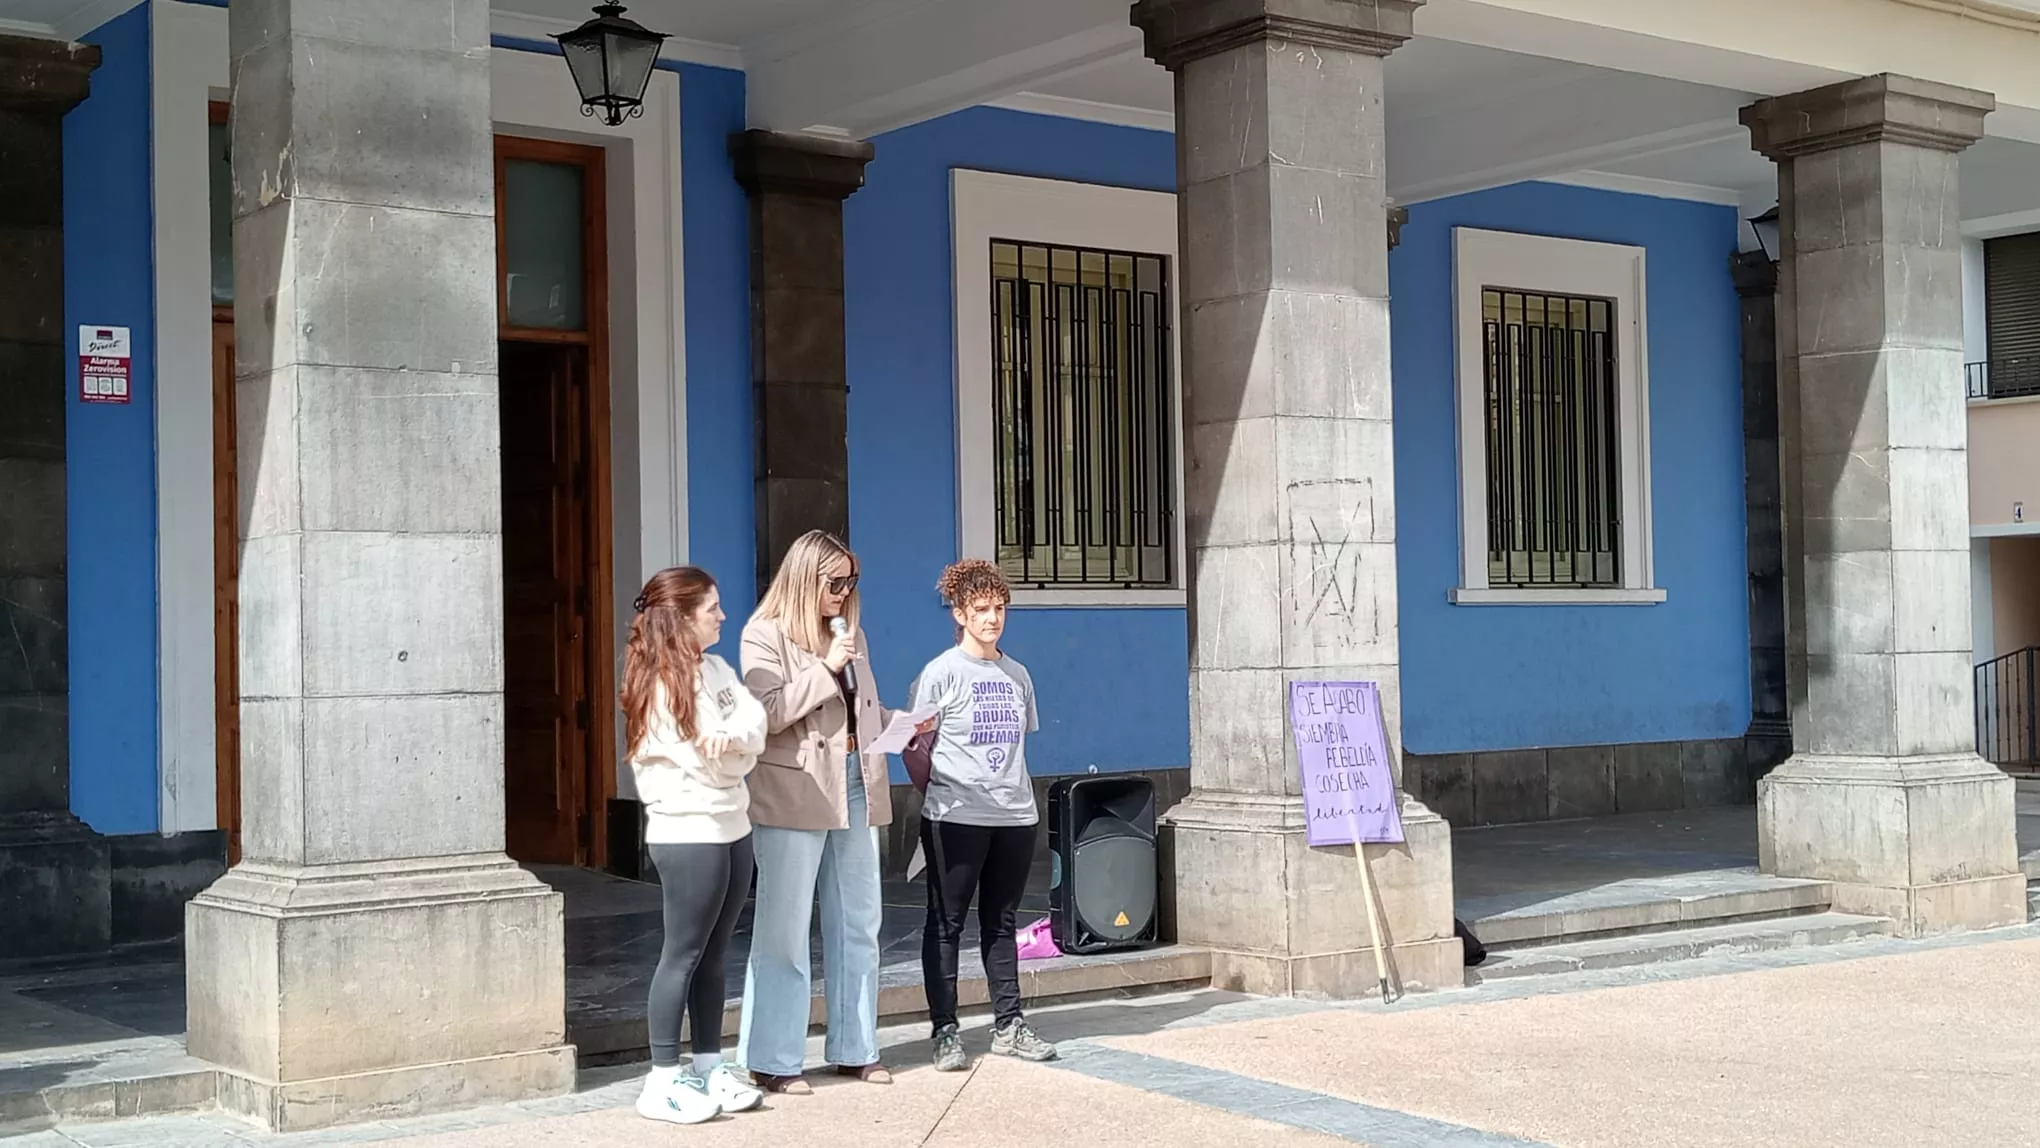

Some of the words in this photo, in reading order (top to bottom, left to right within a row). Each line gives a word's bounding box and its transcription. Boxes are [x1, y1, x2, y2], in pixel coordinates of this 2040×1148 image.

[91, 357, 120, 365] Alarma
[971, 681, 1013, 695] SOMOS
[1296, 685, 1321, 716] SE
[974, 710, 1019, 723] BRUJAS
[970, 730, 1021, 745] QUEMAR
[1315, 770, 1370, 794] COSECHA
[1312, 802, 1389, 821] libertad
